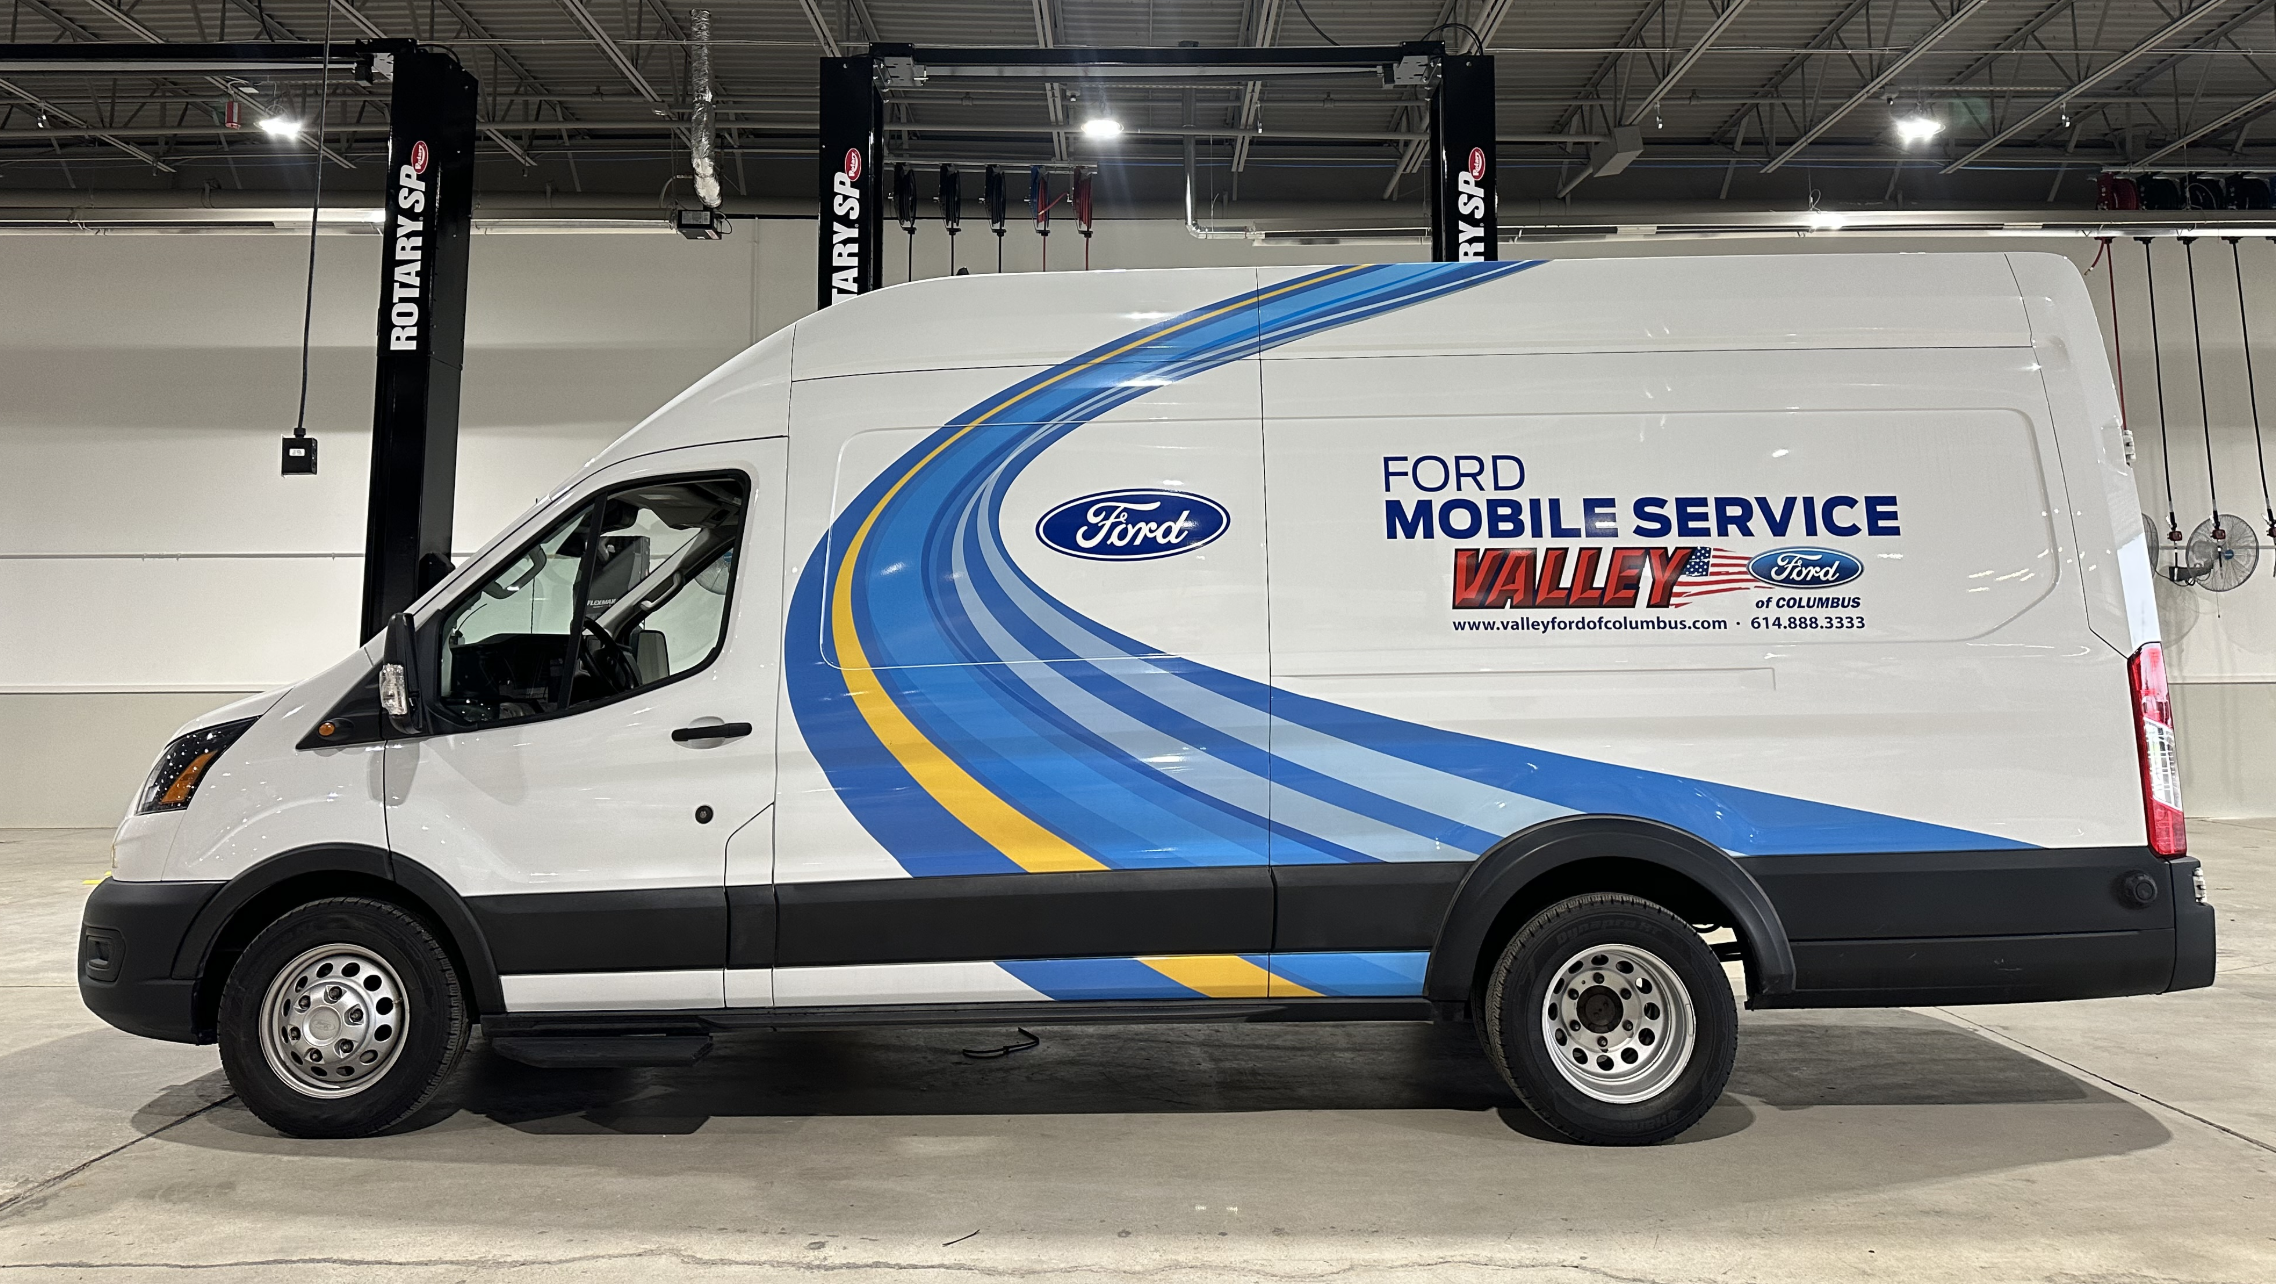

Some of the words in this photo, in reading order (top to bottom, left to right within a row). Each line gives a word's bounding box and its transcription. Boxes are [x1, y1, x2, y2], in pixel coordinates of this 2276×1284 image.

[398, 164, 426, 213] SP
[833, 171, 860, 220] SP
[1458, 170, 1485, 219] SP
[390, 214, 424, 350] ROTARY
[1383, 455, 1526, 492] FORD
[1075, 501, 1191, 549] Ford
[1385, 498, 1619, 539] MOBILE
[1632, 495, 1901, 538] SERVICE
[1452, 547, 1698, 609] VALLEY
[1770, 553, 1840, 582] Ford
[1452, 616, 1728, 634] www.valleyfordofcolumbus.com
[1750, 616, 1865, 630] 614.888.3333
[1755, 596, 1774, 609] of
[1775, 596, 1862, 609] COLUMBUS
